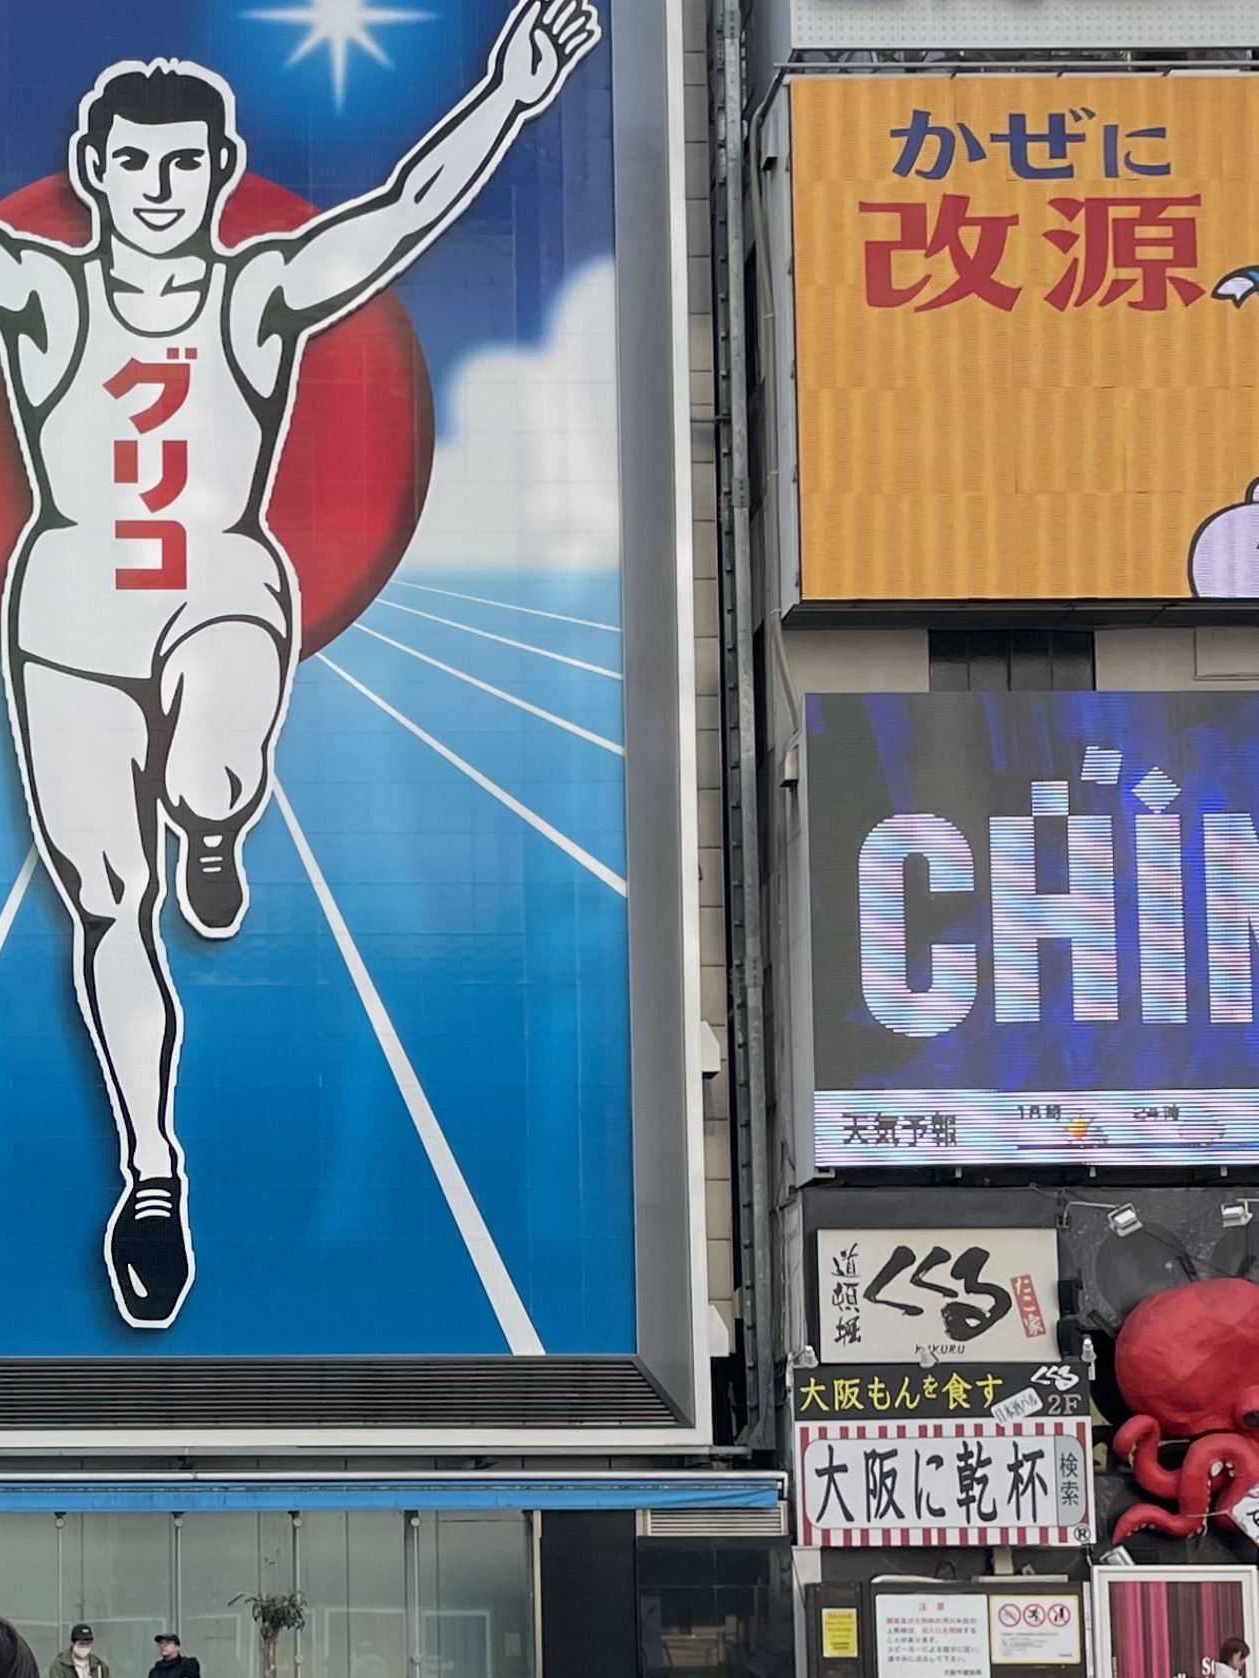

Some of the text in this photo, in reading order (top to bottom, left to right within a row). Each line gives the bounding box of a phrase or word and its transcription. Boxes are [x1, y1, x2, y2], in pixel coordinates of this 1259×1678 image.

[889, 106, 1173, 181] かぜに
[858, 193, 1207, 313] 改源
[102, 347, 198, 590] グリコ
[842, 1111, 957, 1147] 天気予報
[831, 1243, 861, 1346] 道頓堀
[862, 1245, 1012, 1341] くくる
[914, 1344, 966, 1355] KKURU
[799, 1372, 1004, 1412] 大阪もんを食す
[1047, 1394, 1082, 1416] 2F
[813, 1441, 1048, 1525] 大阪に乾杯
[1059, 1453, 1079, 1506] 検索
